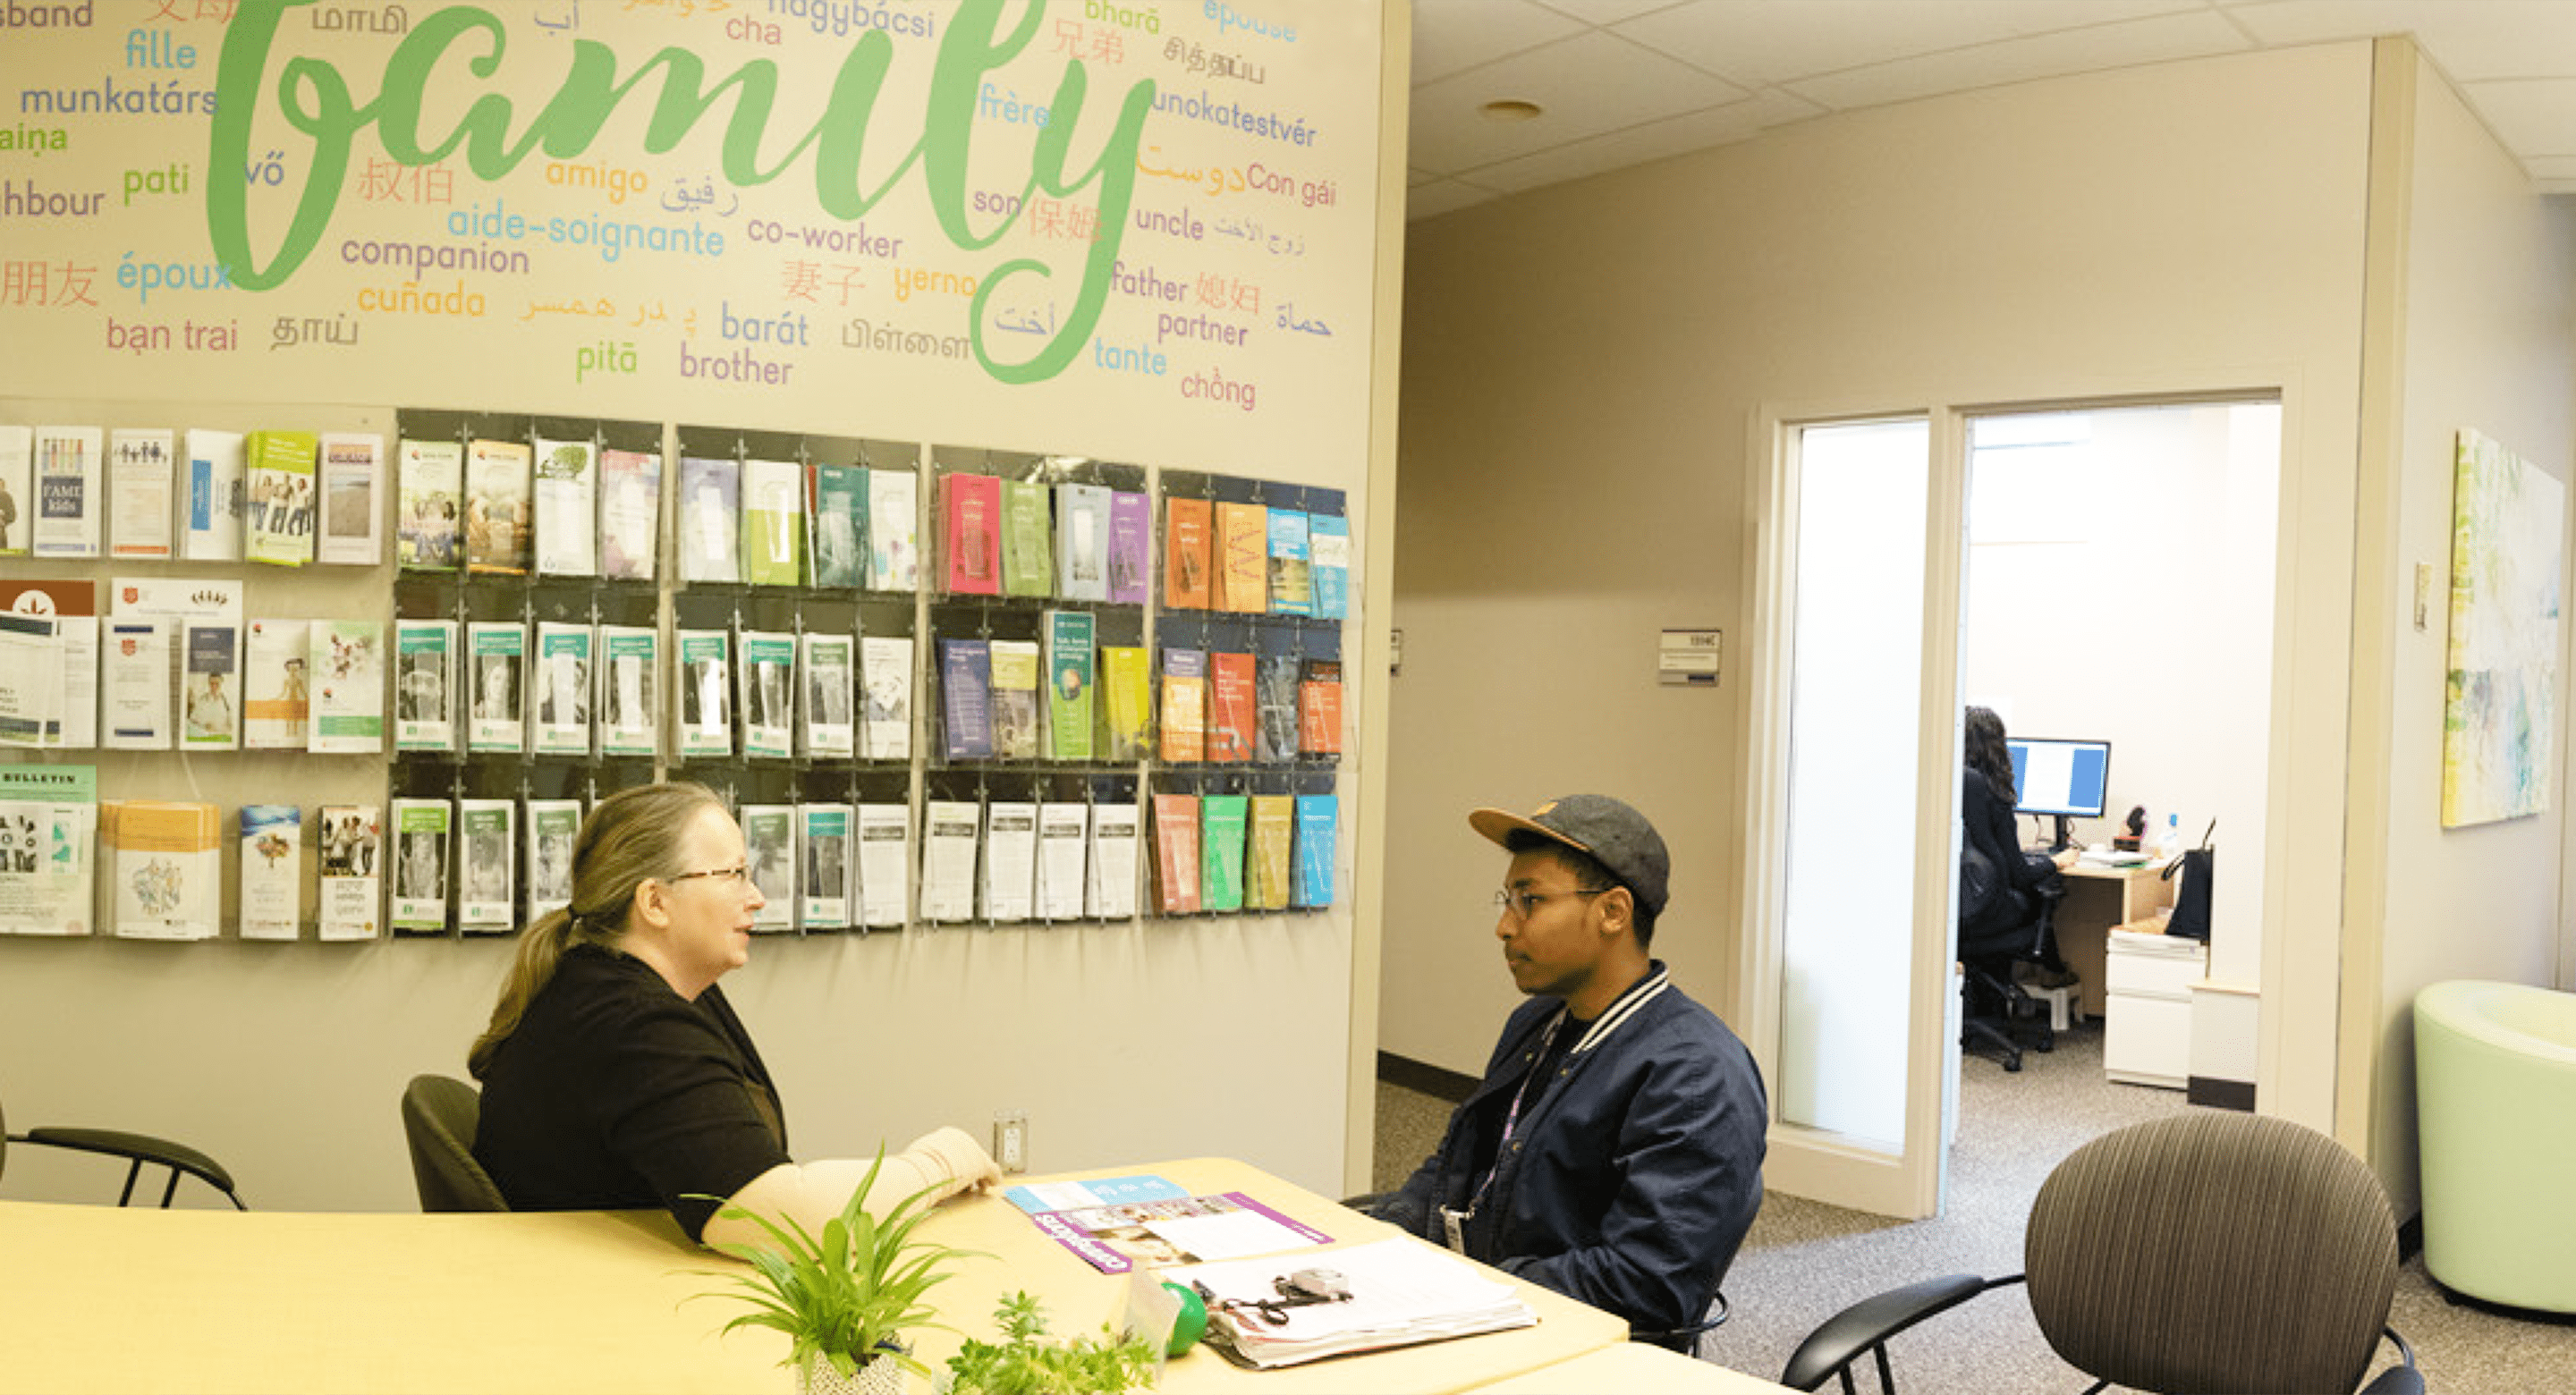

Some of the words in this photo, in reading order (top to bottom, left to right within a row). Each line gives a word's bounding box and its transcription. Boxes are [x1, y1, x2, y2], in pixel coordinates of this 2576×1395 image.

[125, 29, 198, 69] fille
[725, 14, 783, 46] cha
[1053, 18, 1124, 63] 兄弟
[21, 75, 219, 115] munkatárs
[979, 82, 1051, 131] frère
[1152, 90, 1318, 147] unokatestvér
[4, 179, 106, 216] hbour
[123, 164, 190, 207] pati
[206, 0, 1157, 385] family
[359, 156, 453, 204] 叔伯
[546, 162, 648, 205] amigo
[1246, 162, 1295, 196] Con
[1301, 179, 1337, 207] gái
[973, 190, 1021, 218] son
[1030, 197, 1103, 245] 保姆
[1137, 208, 1204, 241] uncle
[448, 198, 724, 263] aide-soignante
[748, 220, 903, 258] co-worker
[116, 250, 233, 305] époux
[342, 240, 530, 281] companion
[1112, 260, 1189, 302] father
[2, 259, 98, 308] 朋友
[359, 278, 487, 317] cuñada
[782, 260, 866, 306] 妻子
[894, 267, 977, 303] yerno
[106, 316, 171, 356] bạn
[184, 318, 238, 351] trai
[722, 300, 809, 347] barát
[1157, 313, 1249, 347] partner
[681, 341, 794, 386] brother
[1094, 337, 1167, 376] tante
